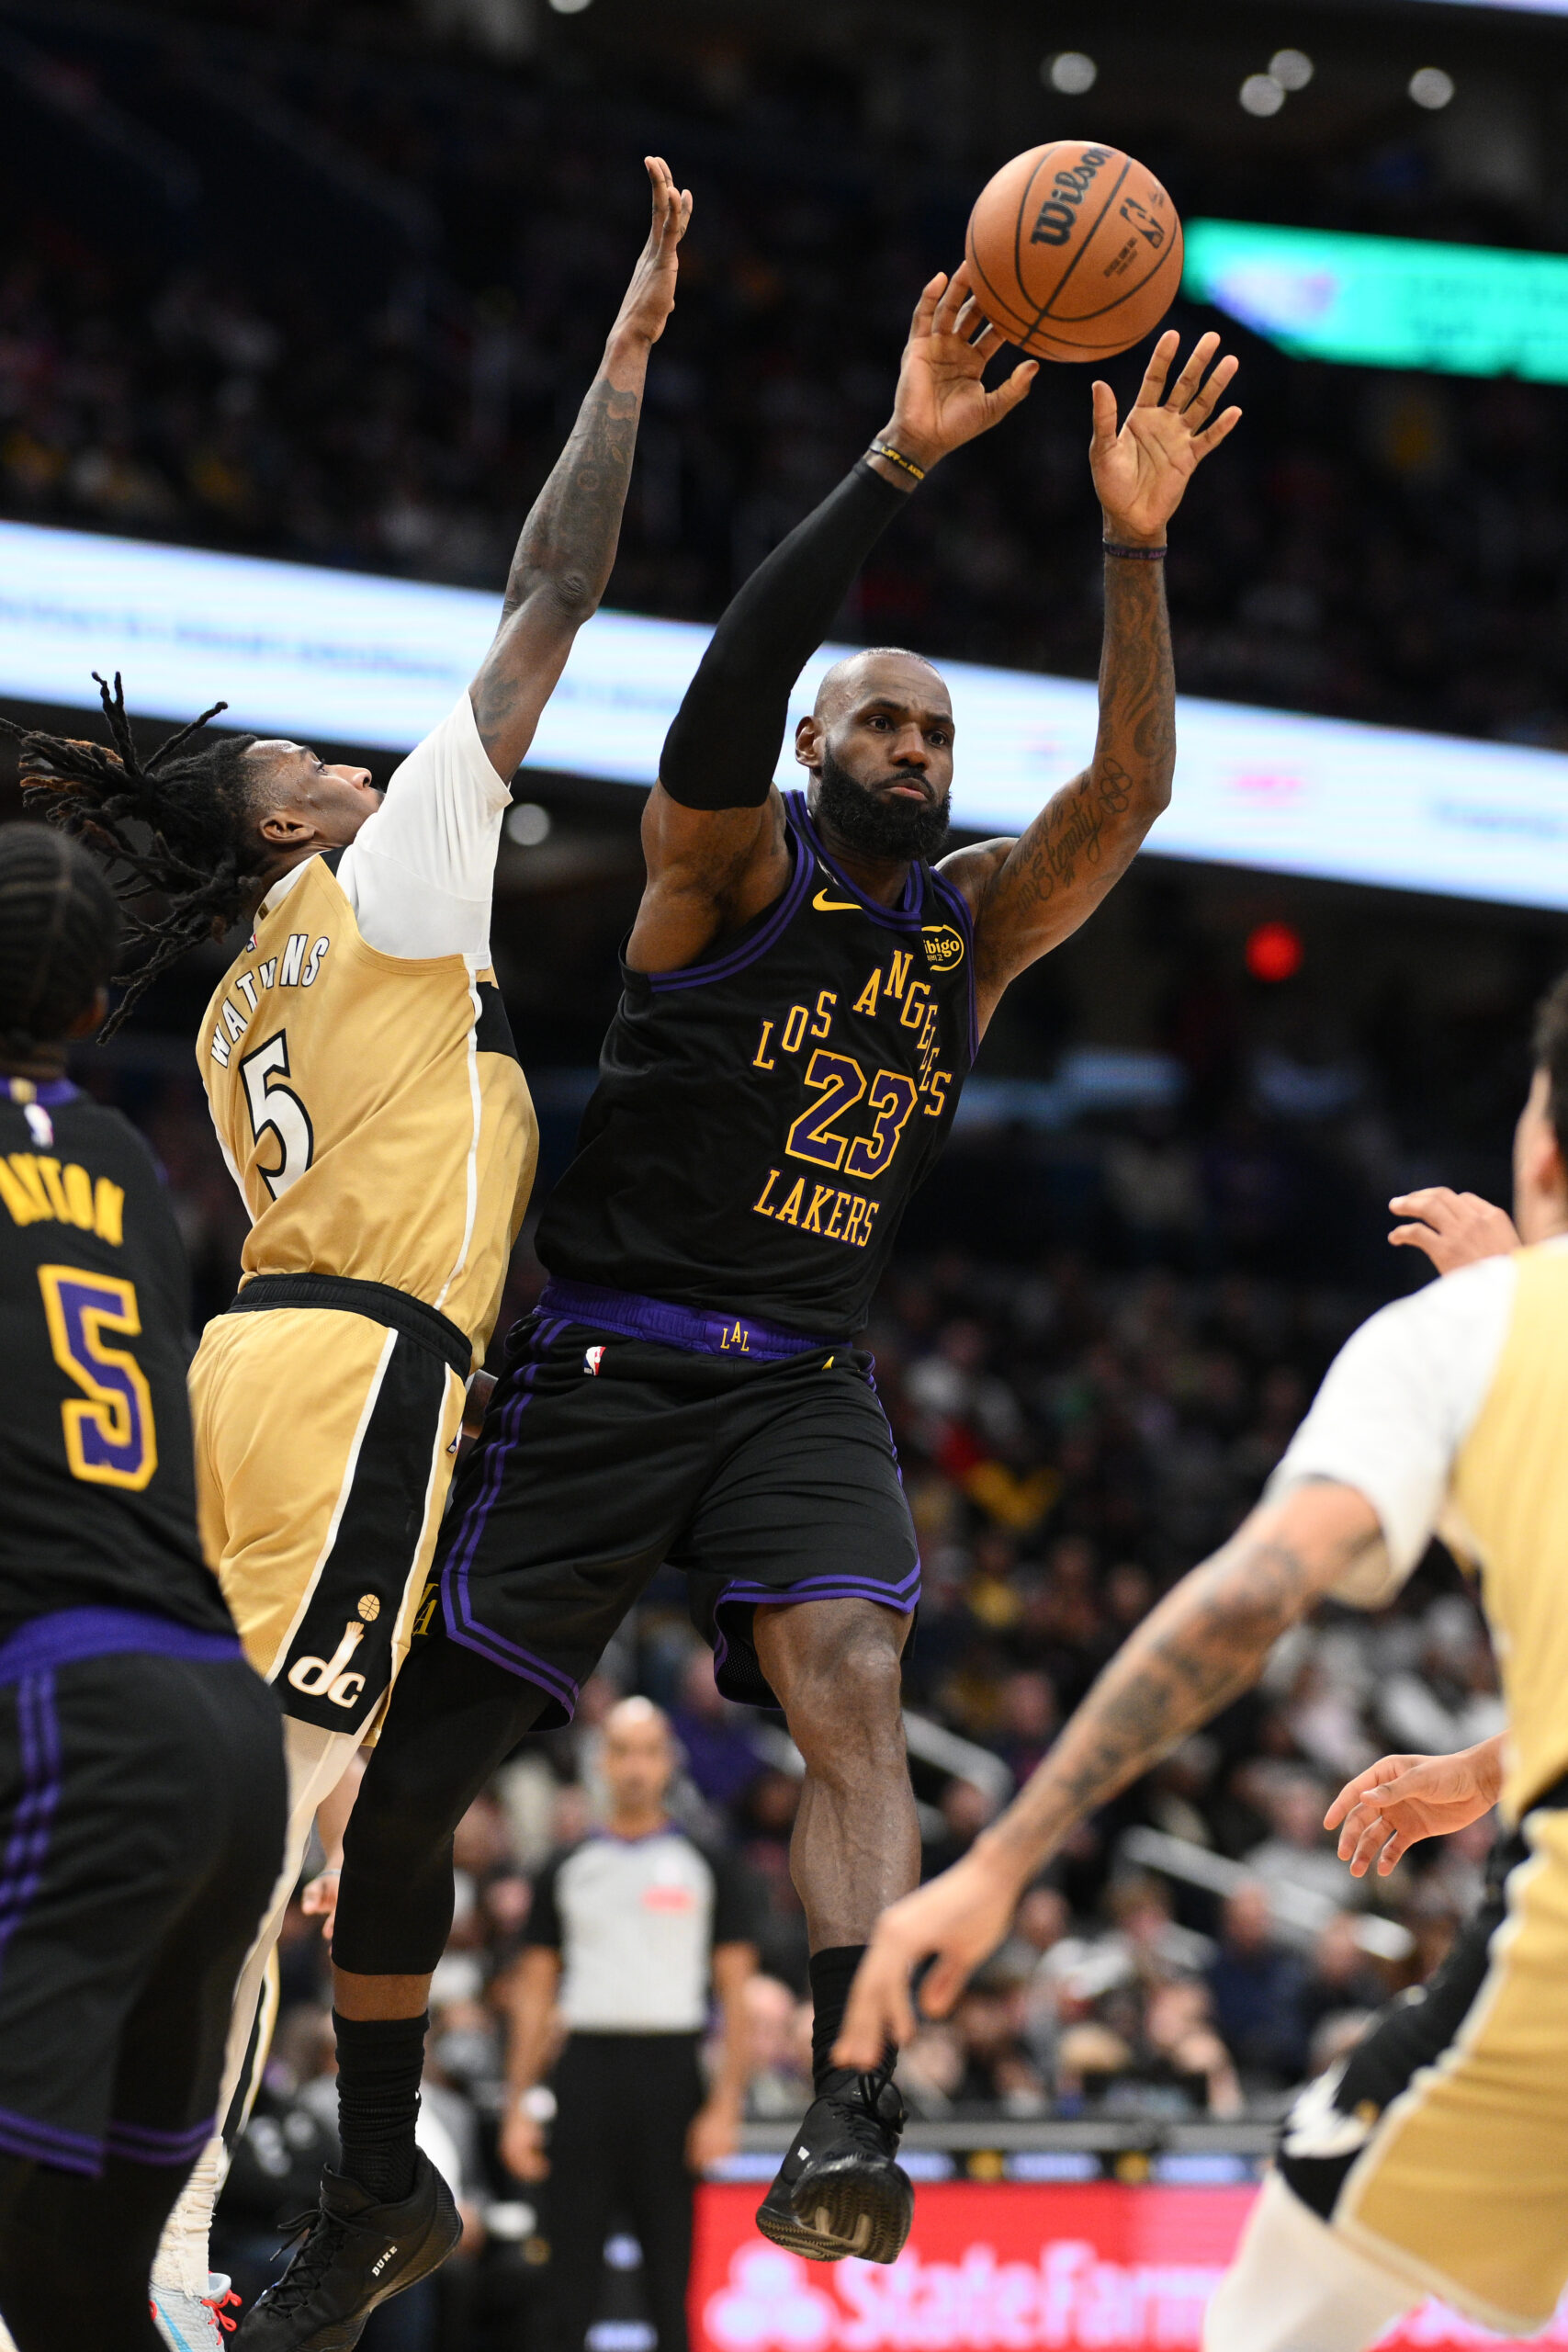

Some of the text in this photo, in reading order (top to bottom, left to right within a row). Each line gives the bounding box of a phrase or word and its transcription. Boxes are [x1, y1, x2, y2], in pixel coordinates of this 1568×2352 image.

[1031, 147, 1116, 246] Wilson
[923, 938, 960, 957] ibigo
[752, 949, 953, 1116] LOS ANGELES
[239, 1027, 314, 1204] 5
[784, 1047, 919, 1181] 23
[752, 1168, 880, 1248] LAKERS
[37, 1263, 159, 1492] 5
[720, 1321, 750, 1352] LAL
[288, 1621, 367, 1710] dc
[371, 2245, 398, 2278] DUKE
